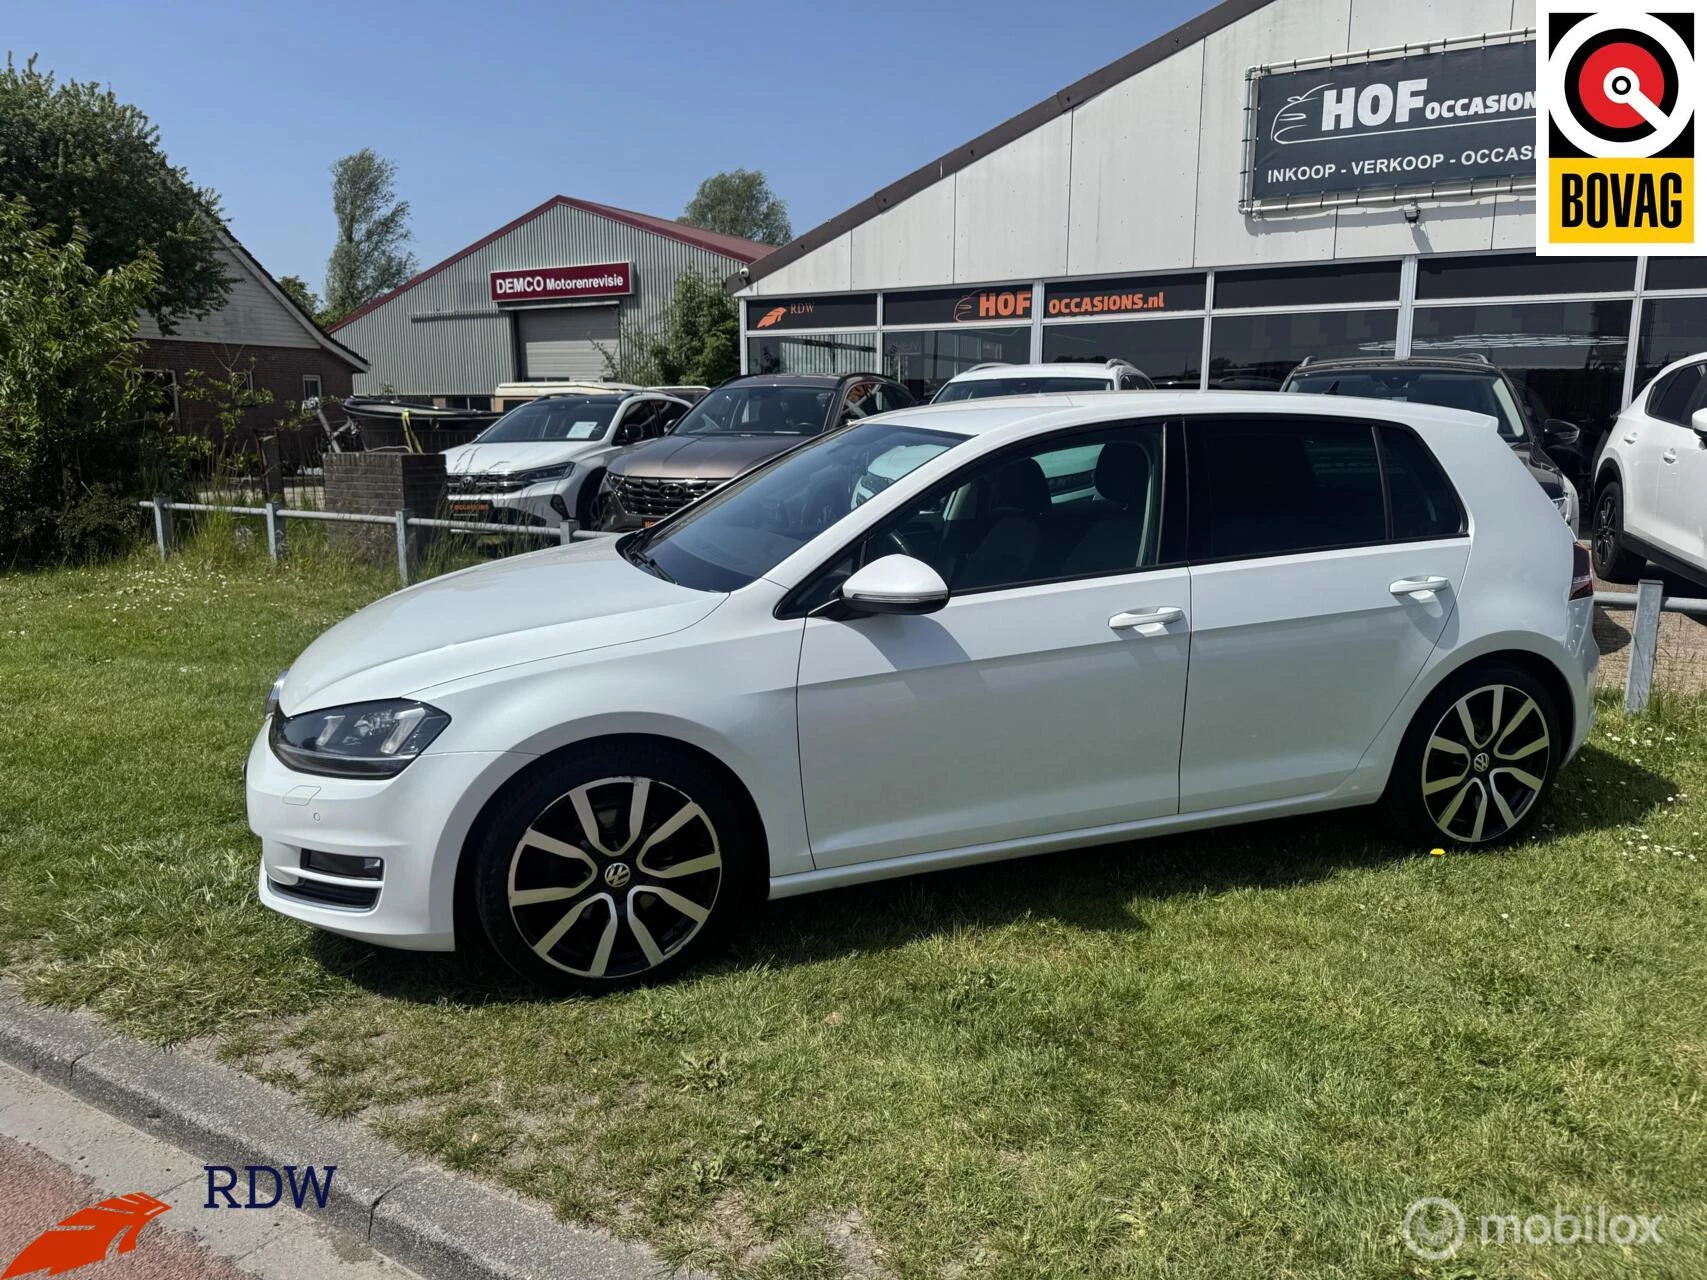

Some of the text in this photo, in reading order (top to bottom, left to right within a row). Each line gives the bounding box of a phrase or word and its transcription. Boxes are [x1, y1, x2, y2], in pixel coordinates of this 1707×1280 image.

[1321, 78, 1428, 131] HOF
[1267, 164, 1336, 184] INKOOP
[1351, 153, 1445, 175] VERKOOP
[496, 274, 624, 294] DEMCO Motorenrevisie
[790, 302, 815, 314] RDW
[979, 291, 1165, 317] HOF OCCASIONS.nl
